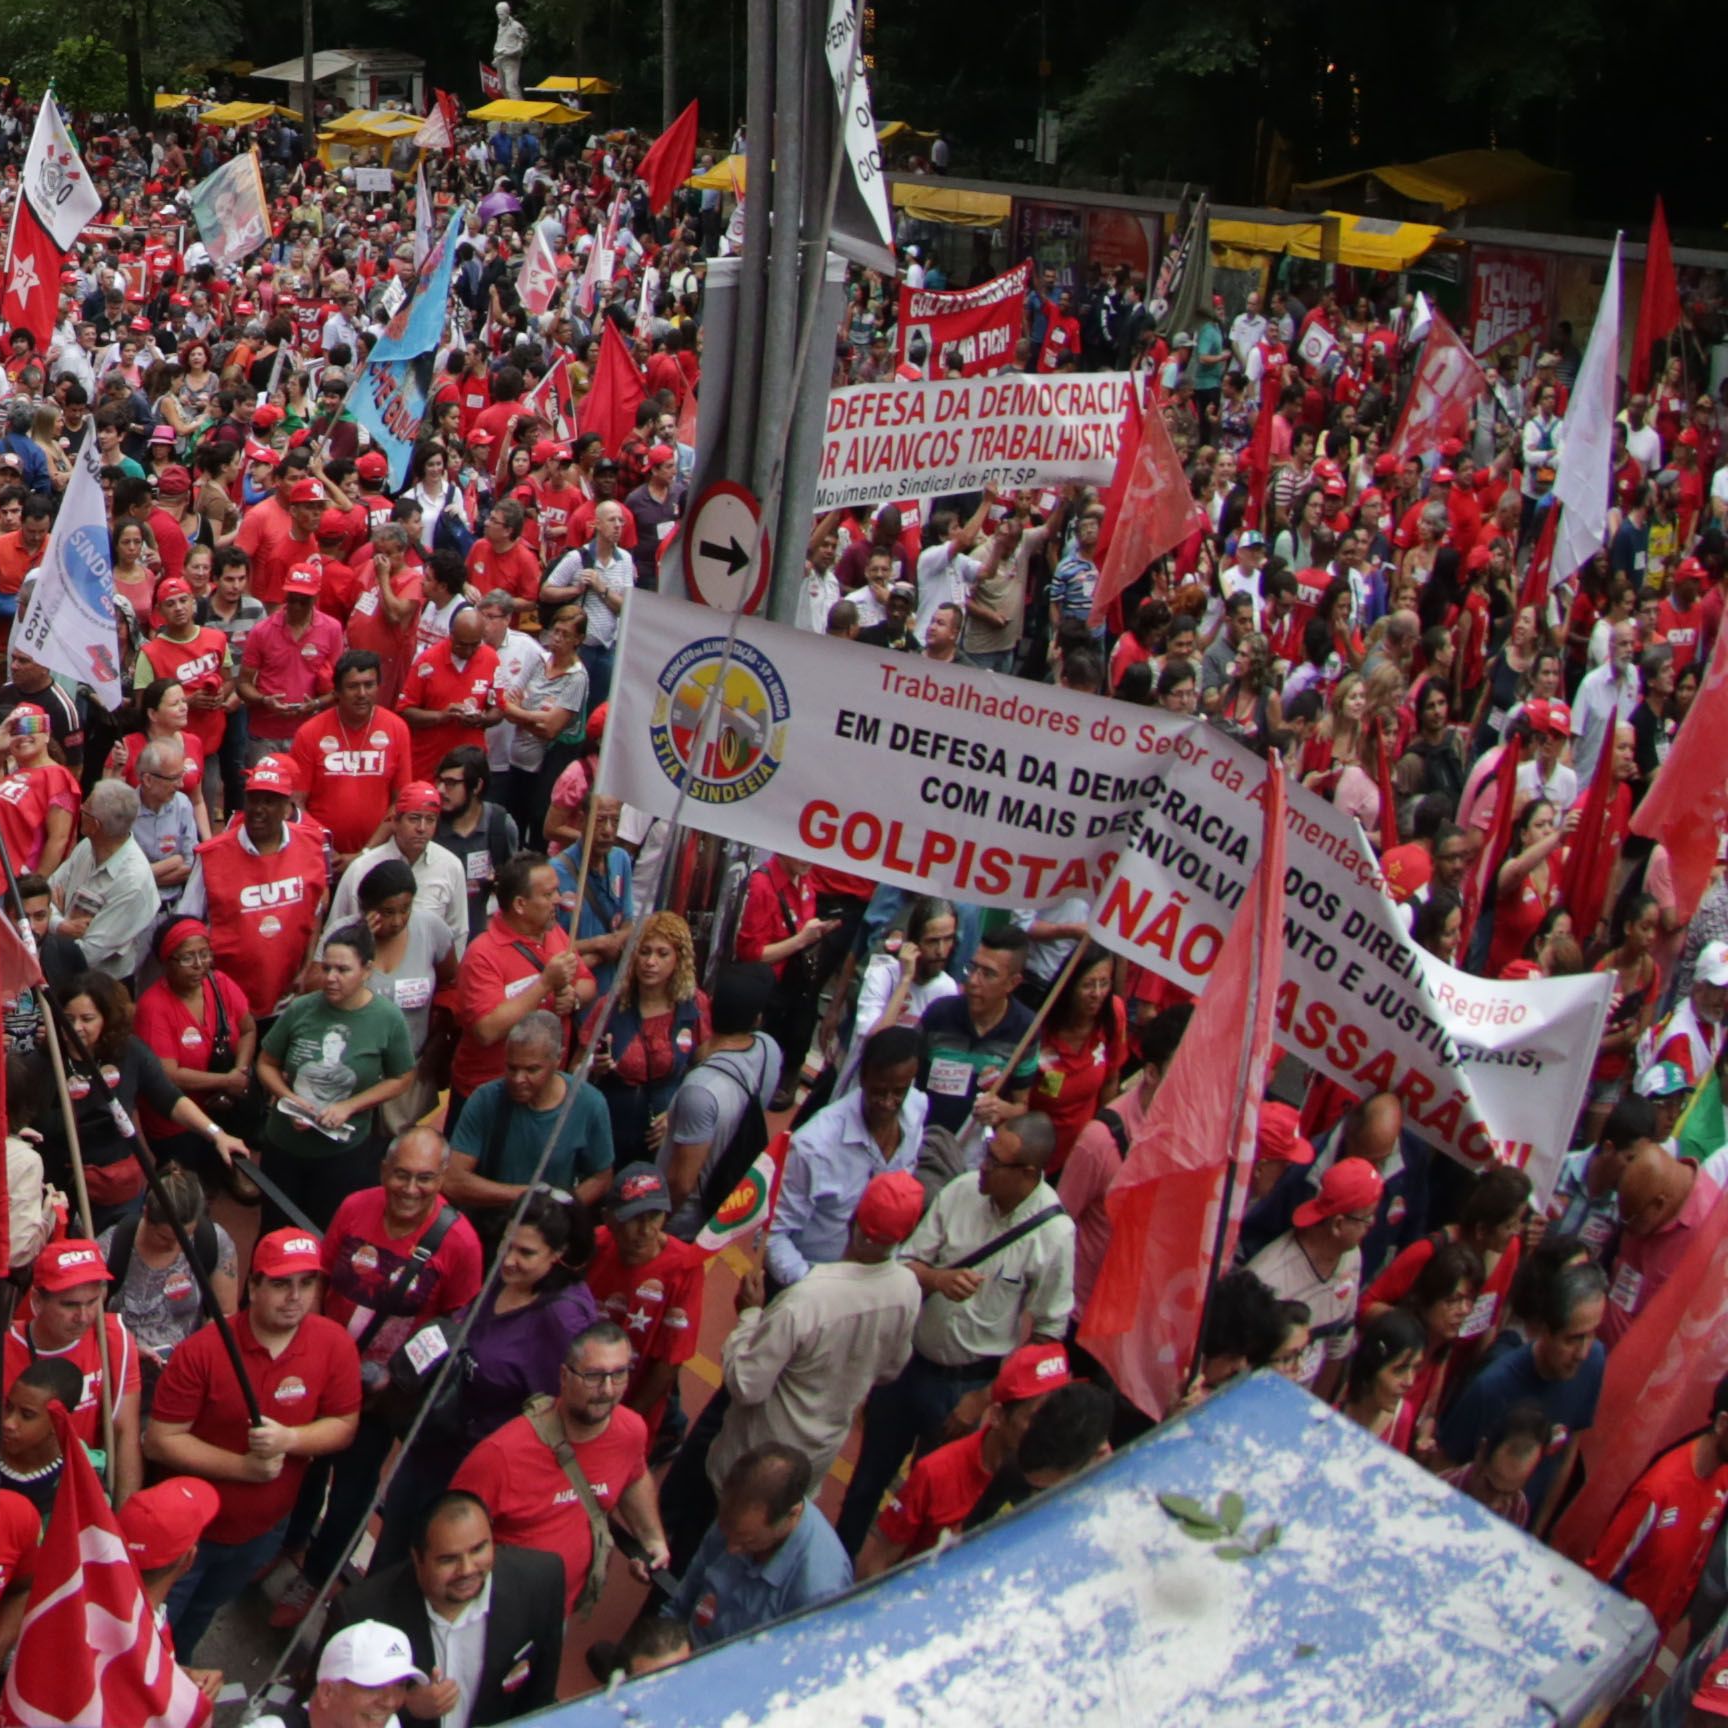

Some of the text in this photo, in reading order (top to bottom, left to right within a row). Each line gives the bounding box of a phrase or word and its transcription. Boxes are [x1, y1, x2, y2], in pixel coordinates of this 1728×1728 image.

[827, 381, 1132, 433] DEFESA DA DEMOCRACIA
[842, 427, 964, 474] AVANÇOS
[815, 470, 978, 508] Movimento Sindical do
[177, 652, 217, 681] CUT
[880, 664, 1246, 792] Trabalhadores do Setor da
[324, 751, 380, 774] CUT
[651, 726, 775, 805] STIA SINDEEIA
[834, 709, 1341, 922] EM DEFESA DA DEMOCRACIA DOS
[241, 877, 299, 909] CUT
[798, 799, 1121, 901] GOLPISTAS
[1096, 876, 1225, 976] NÃO
[920, 775, 1365, 992] COM MAIS E
[1437, 982, 1528, 1026] Região
[58, 1250, 94, 1266] CUT
[1036, 1357, 1065, 1377] CUT
